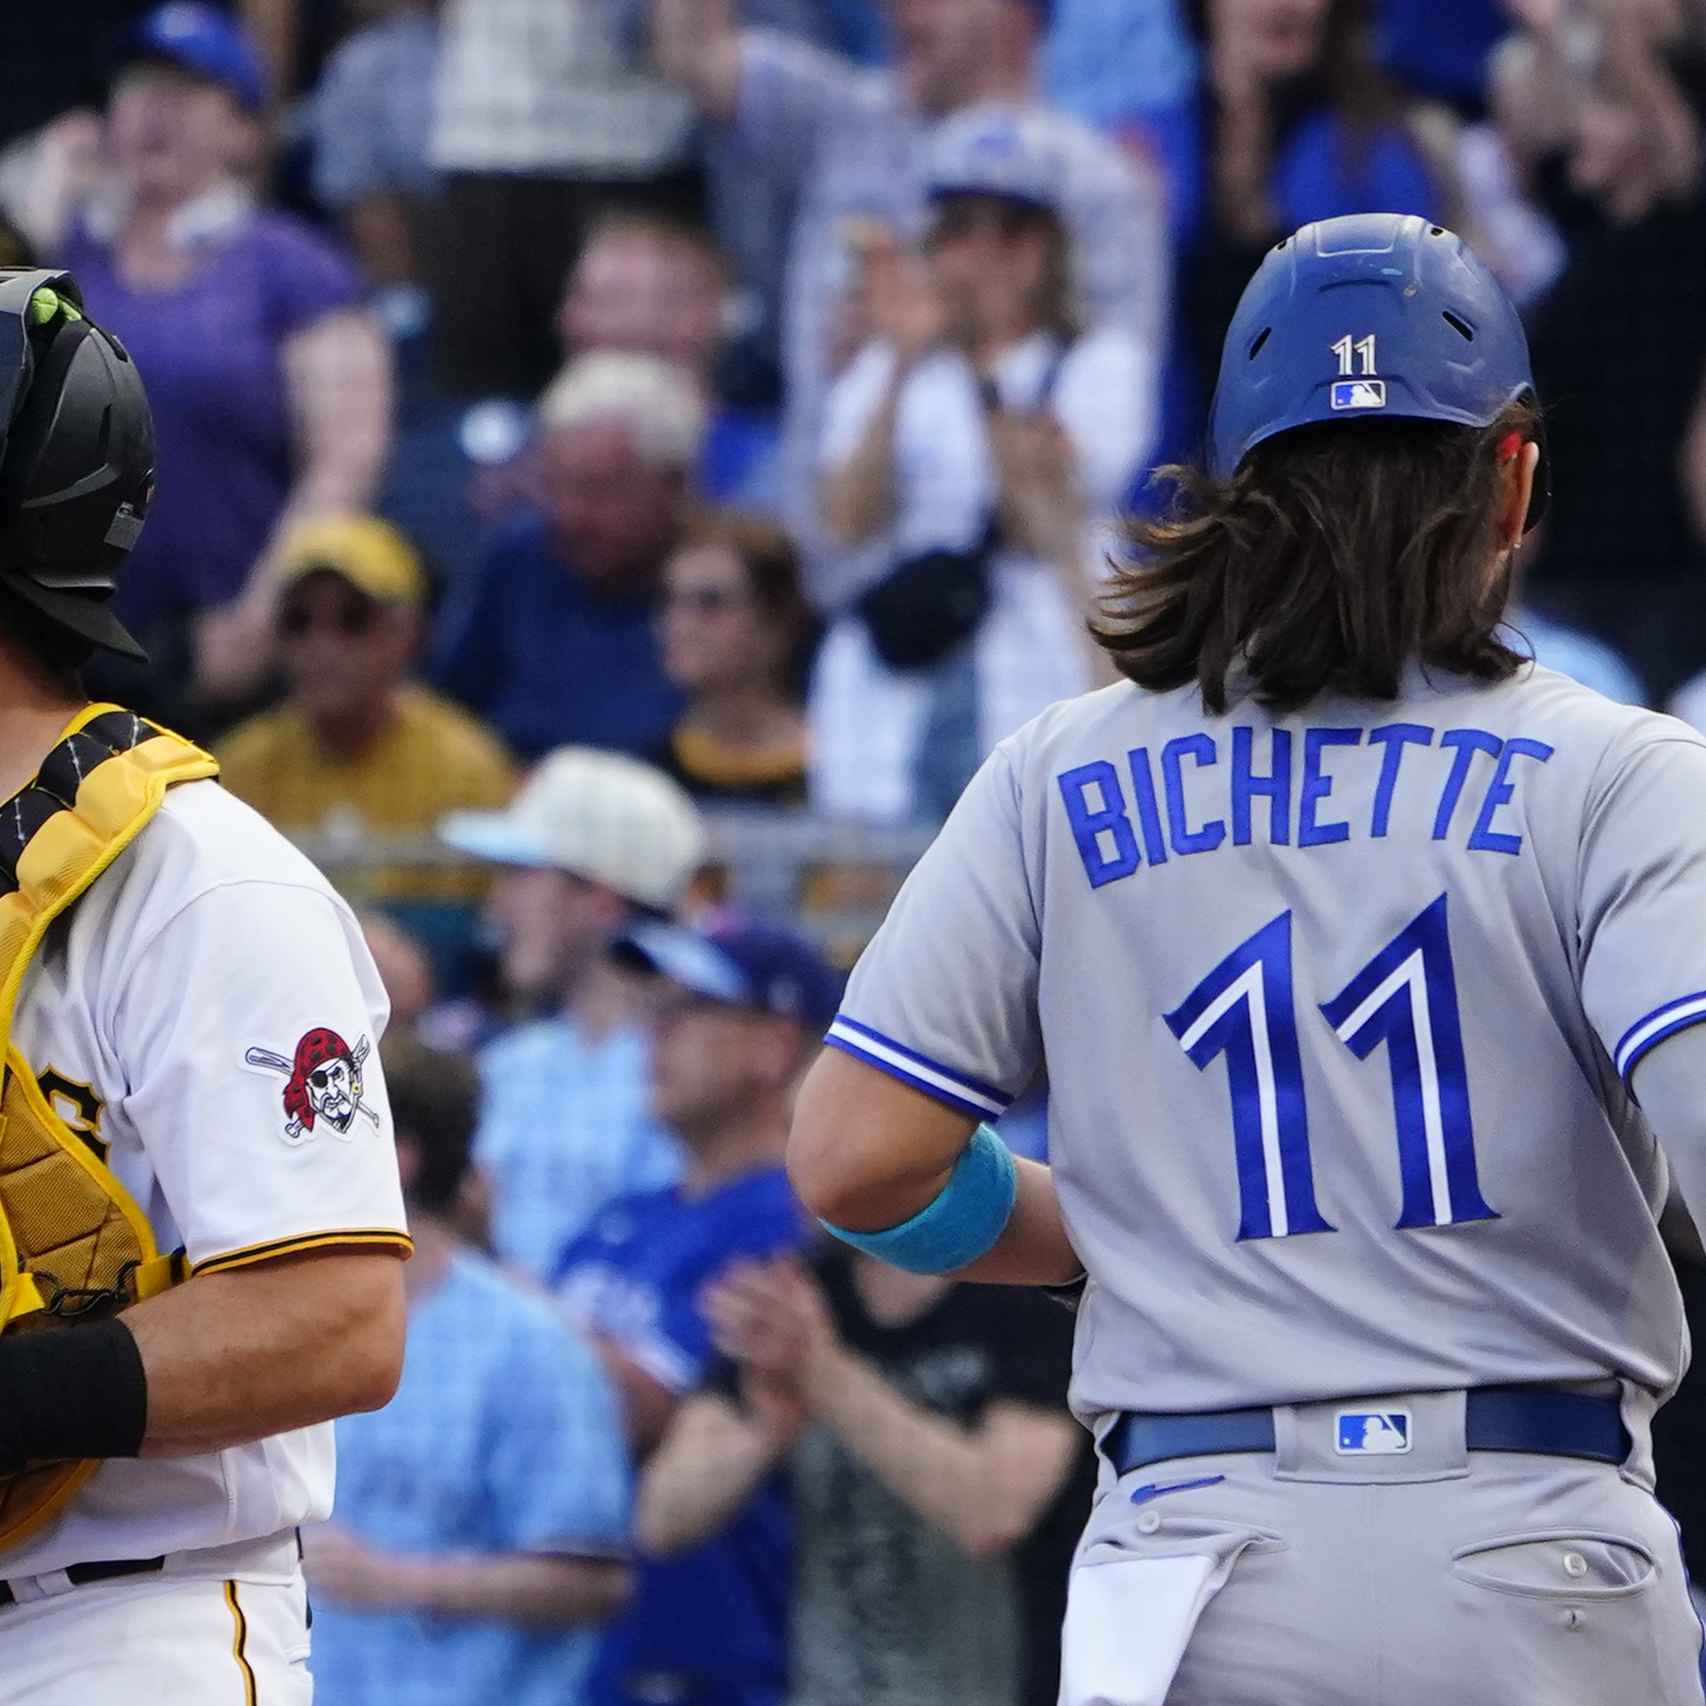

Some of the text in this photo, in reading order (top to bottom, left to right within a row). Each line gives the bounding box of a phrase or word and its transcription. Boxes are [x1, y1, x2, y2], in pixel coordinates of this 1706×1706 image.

[1330, 333, 1378, 377] 11
[1057, 722, 1556, 890] BICHETTE
[1162, 891, 1502, 1243] 11
